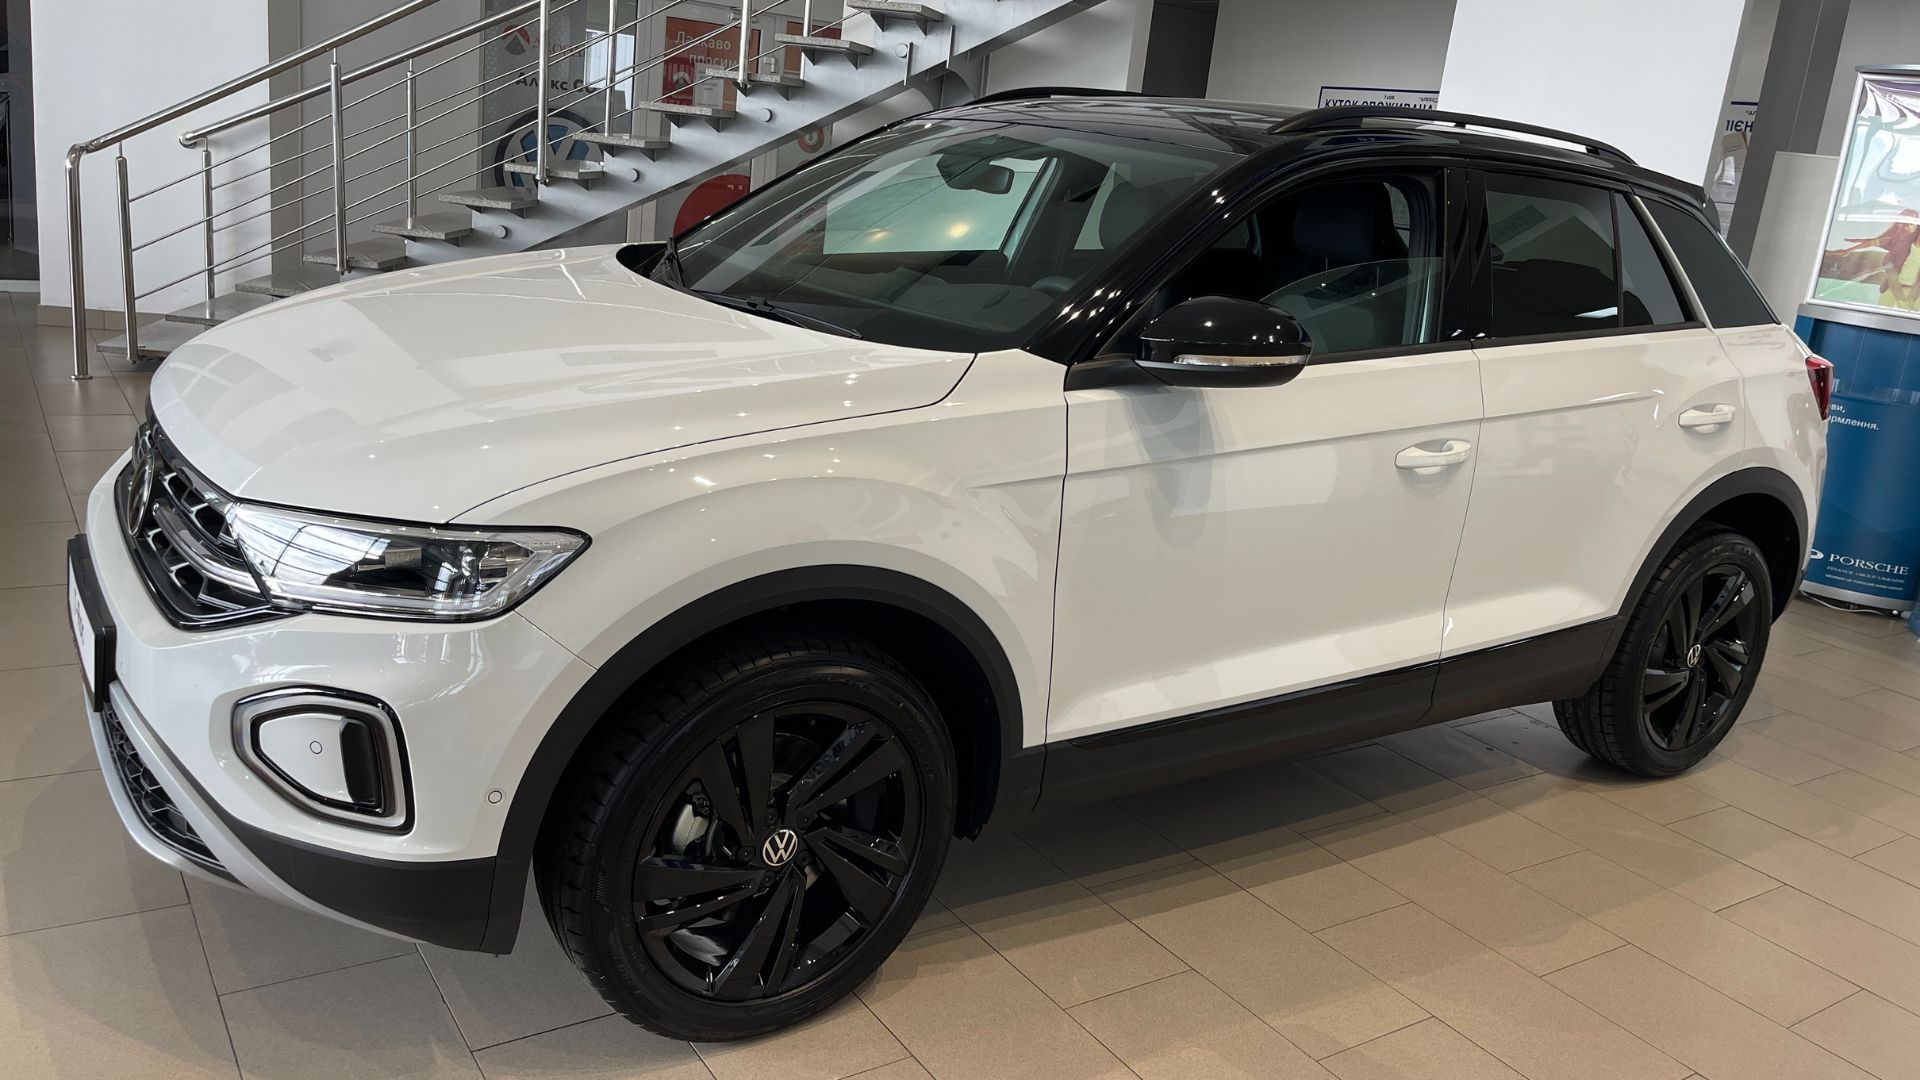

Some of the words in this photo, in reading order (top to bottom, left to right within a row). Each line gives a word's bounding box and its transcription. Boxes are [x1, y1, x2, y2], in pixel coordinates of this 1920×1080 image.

[674, 31, 731, 51] Лакаво
[515, 72, 568, 91] Алкс
[1830, 403, 1846, 414] ви,
[1829, 553, 1909, 576] PORSCHE
[763, 829, 798, 867] VW
